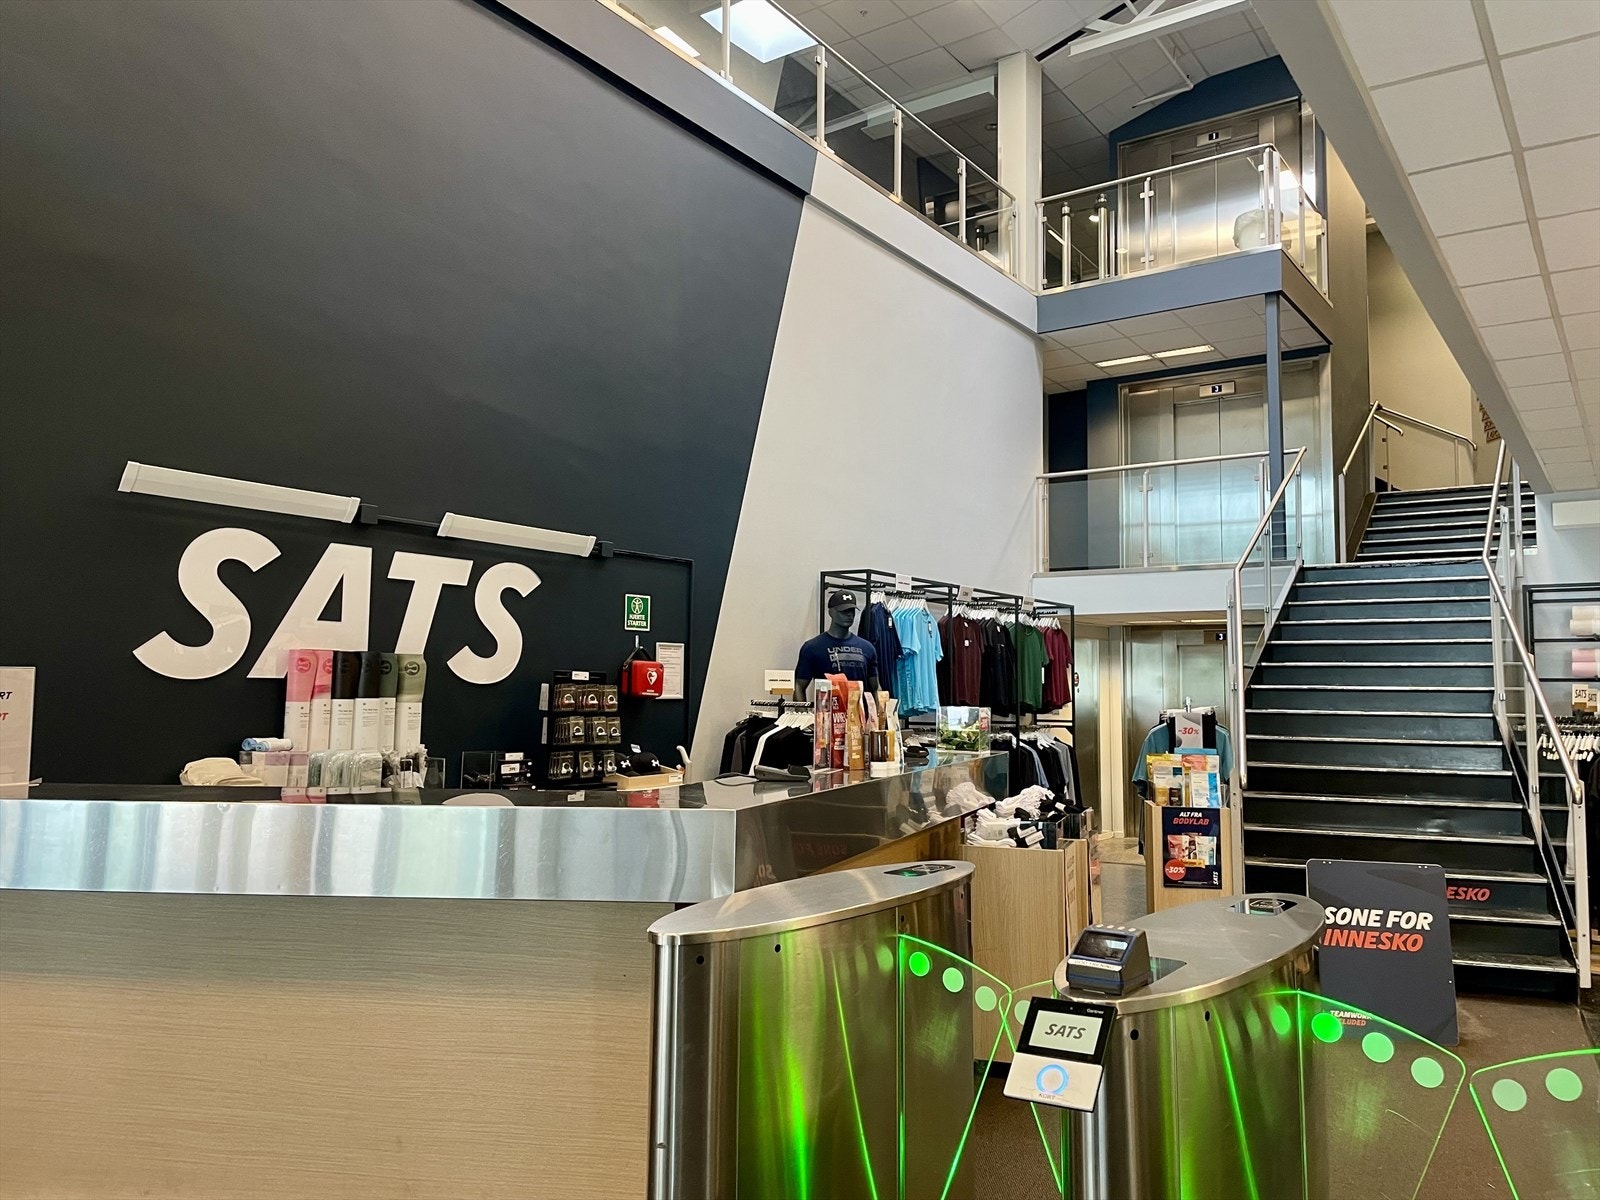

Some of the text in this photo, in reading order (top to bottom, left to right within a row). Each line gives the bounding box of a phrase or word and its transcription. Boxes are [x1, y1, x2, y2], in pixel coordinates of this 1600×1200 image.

[132, 527, 542, 685] SATS
[827, 646, 864, 655] UNDER
[1574, 689, 1587, 699] SATS
[1178, 727, 1200, 735] -30%
[1172, 818, 1210, 826] BODYLAB
[1166, 866, 1185, 874] -30%
[1446, 886, 1491, 902] ESKO
[1325, 906, 1434, 931] SONE FOR
[1323, 928, 1424, 953] INNESKO
[1044, 1023, 1087, 1040] SATS
